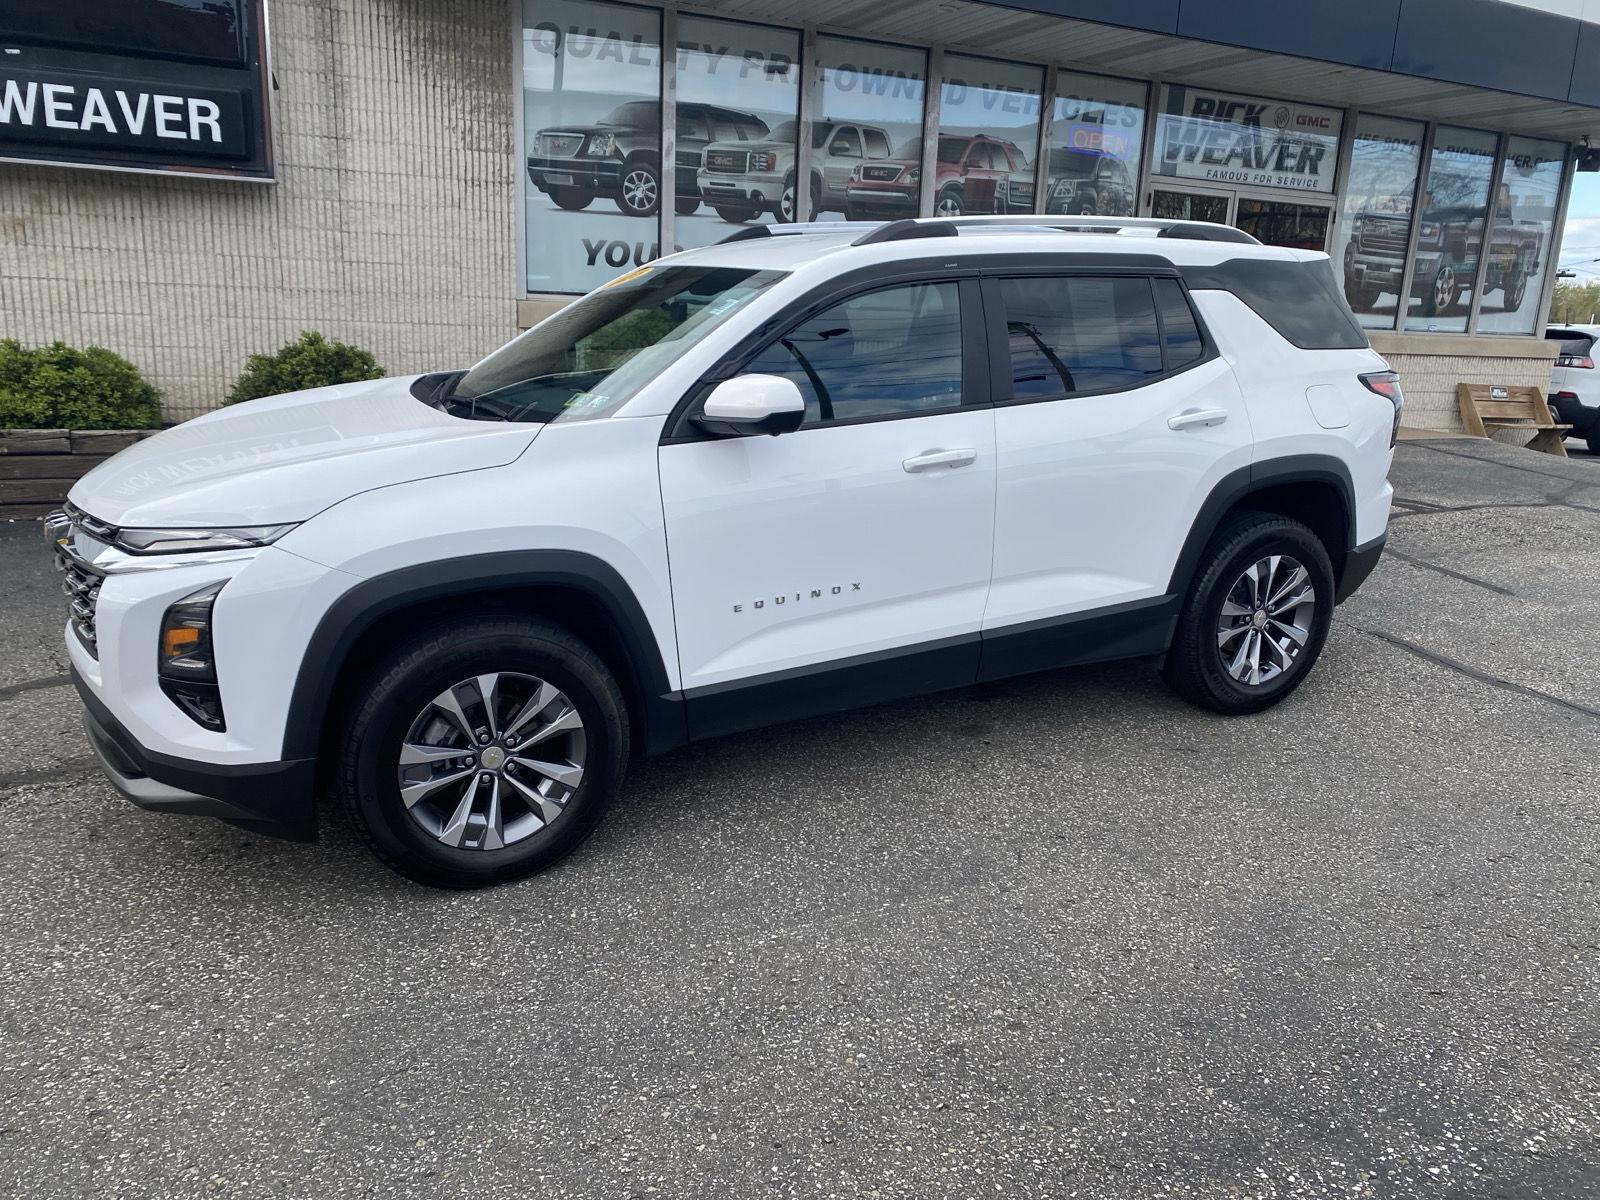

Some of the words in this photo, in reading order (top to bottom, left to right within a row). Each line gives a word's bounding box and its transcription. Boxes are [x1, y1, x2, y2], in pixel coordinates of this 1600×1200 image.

[532, 21, 733, 75] QUALTY
[0, 79, 222, 143] WEAVER
[1188, 97, 1270, 131] RICK
[1296, 114, 1330, 128] GMC
[1073, 128, 1129, 153] OPEN
[1164, 122, 1326, 175] WEAVER
[1206, 169, 1249, 182] FAMOUS
[1253, 174, 1272, 184] FOR
[1277, 176, 1319, 188] SERVICE
[733, 582, 861, 613] EQUINOX
